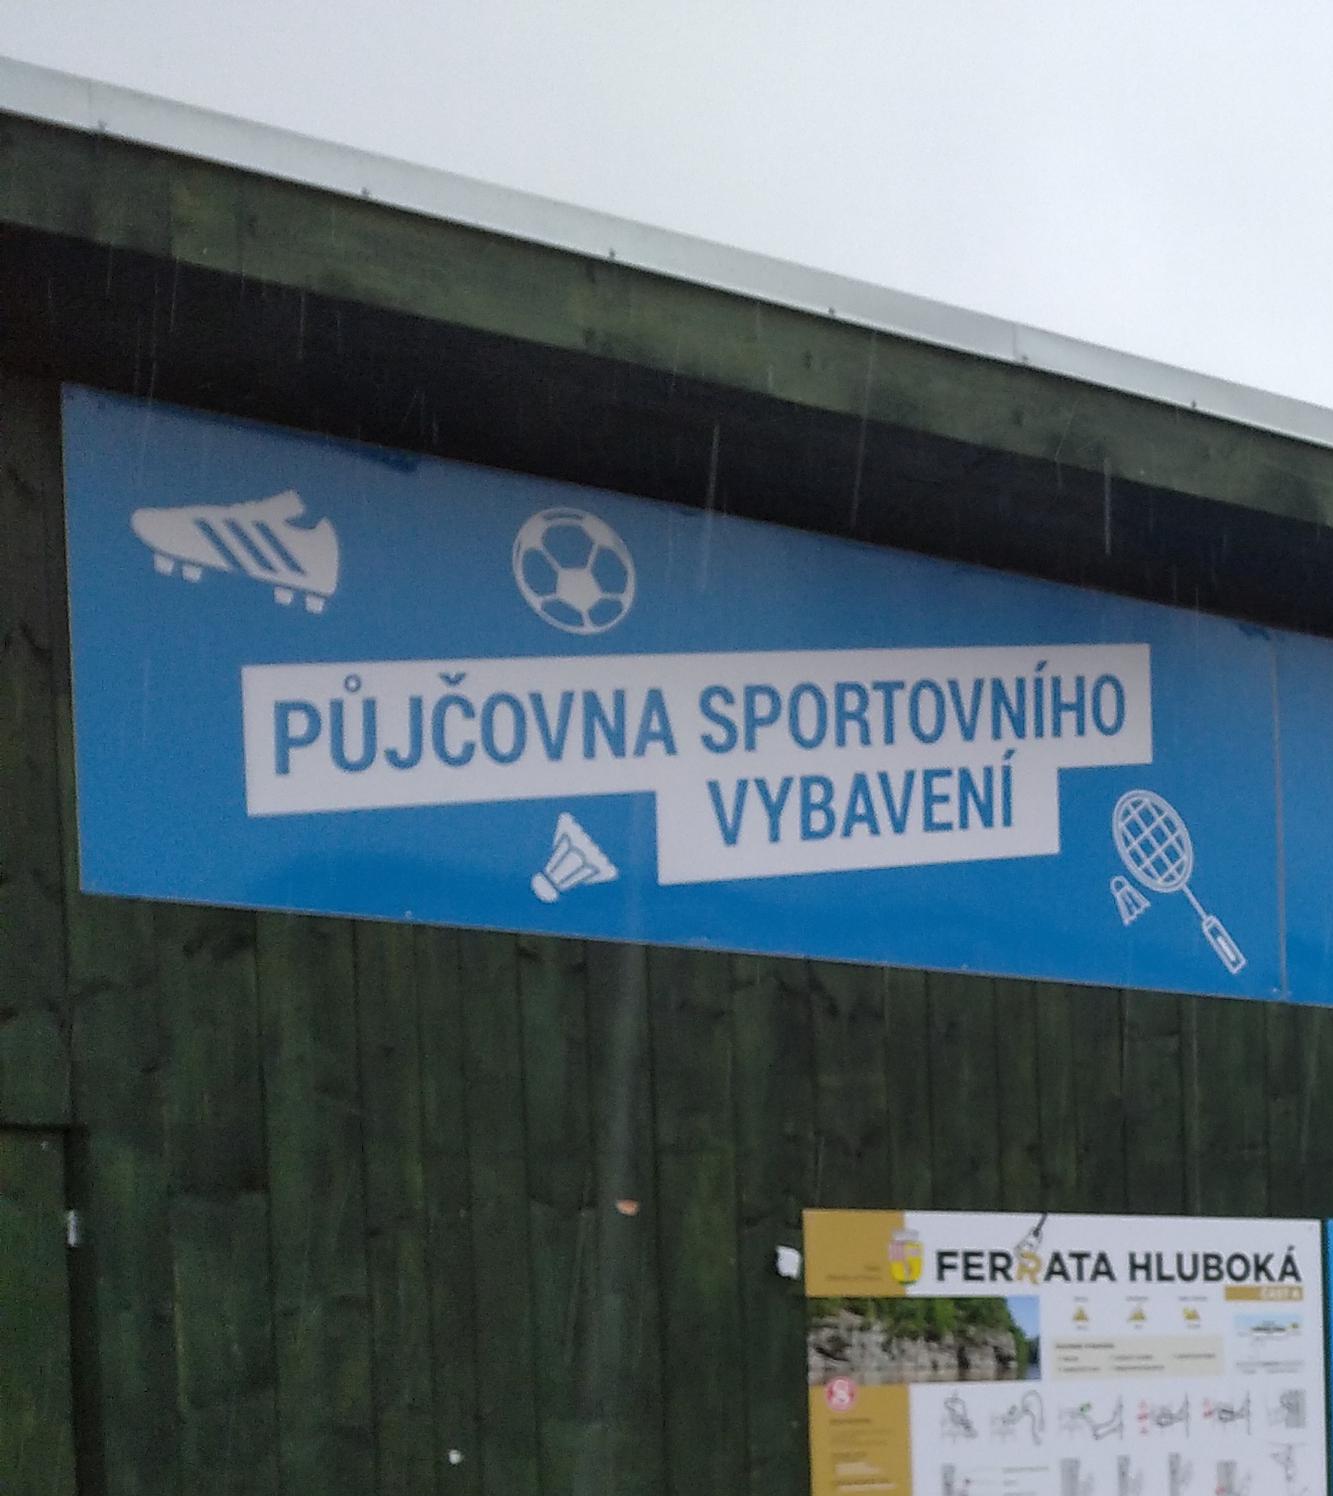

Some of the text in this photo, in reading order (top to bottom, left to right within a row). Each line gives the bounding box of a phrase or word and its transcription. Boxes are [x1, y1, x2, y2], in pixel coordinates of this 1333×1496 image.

[272, 659, 1127, 775] PŮJČOVNA SPORTOVNÍHO
[706, 750, 1014, 848] VYBAVENÍ
[935, 1245, 1303, 1285] FERRATA HLUBOKÁ
